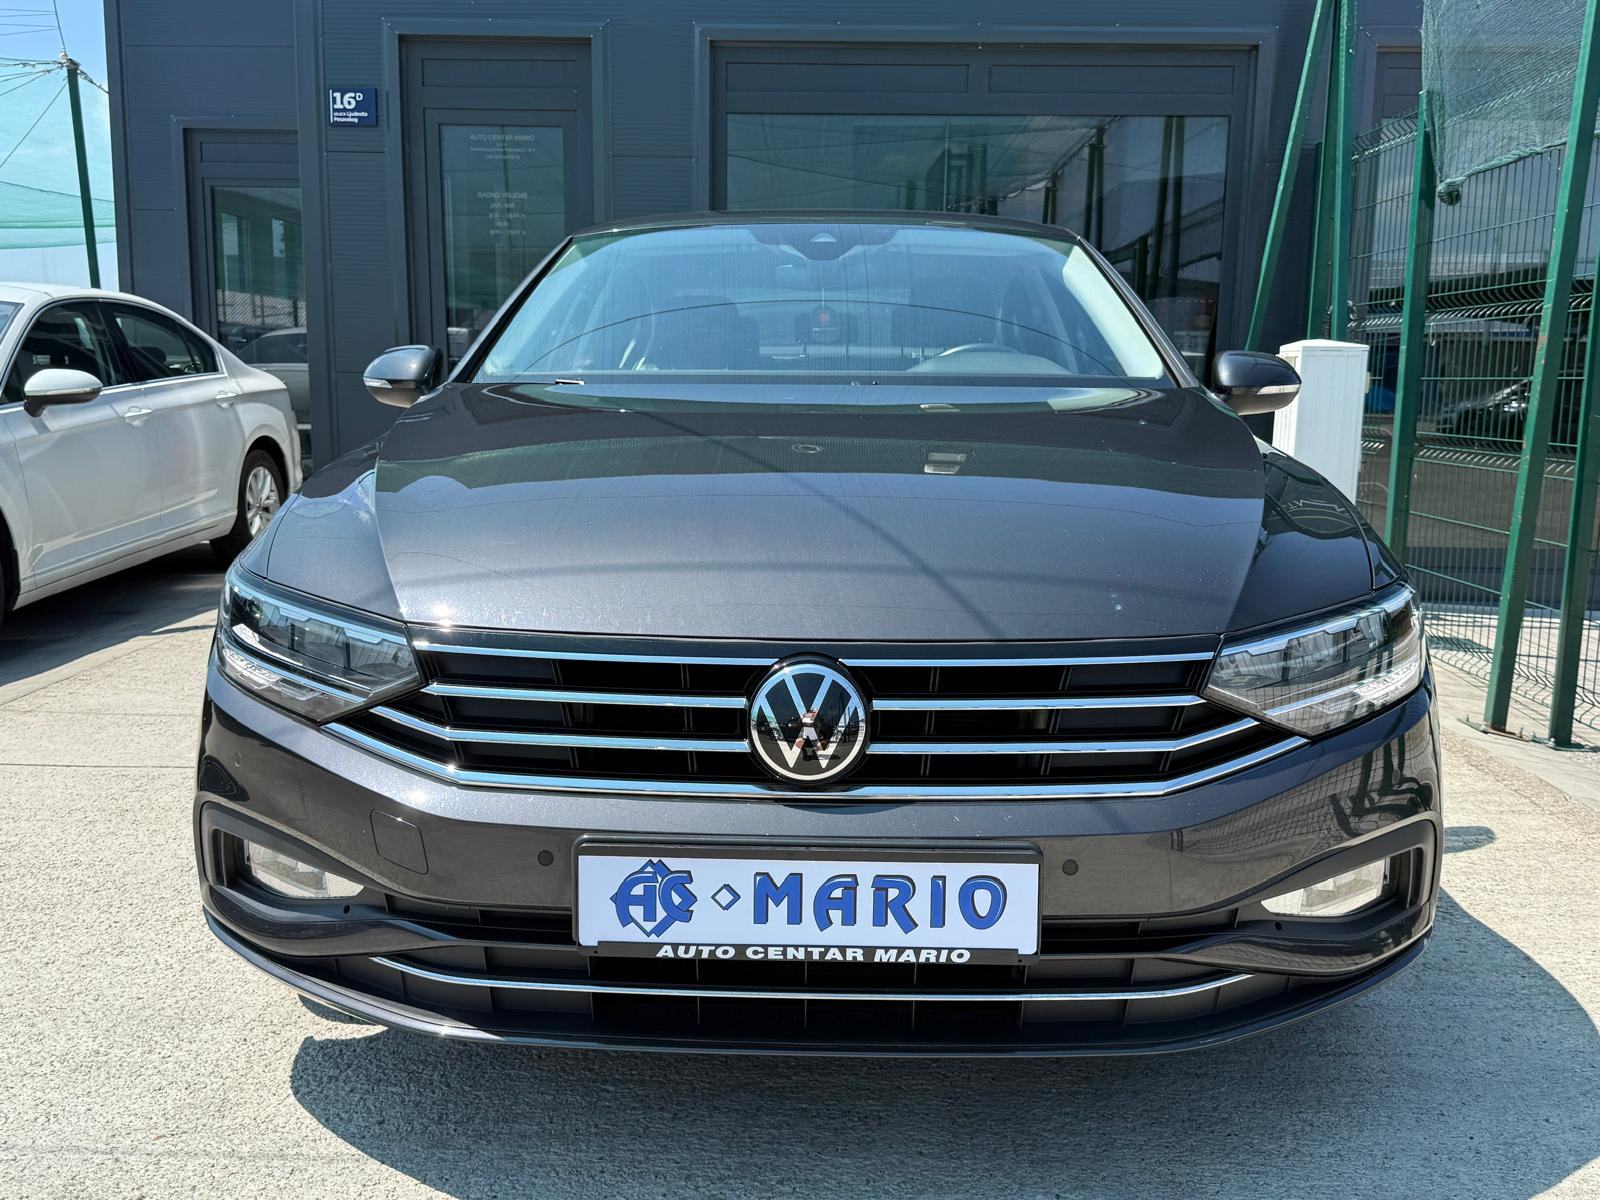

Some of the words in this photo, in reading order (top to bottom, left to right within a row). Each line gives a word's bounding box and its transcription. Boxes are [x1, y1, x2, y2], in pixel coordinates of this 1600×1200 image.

[753, 871, 1008, 935] MARIO
[656, 944, 736, 960] AUTO
[745, 945, 865, 962] CENTAR
[872, 948, 971, 964] MARIO
